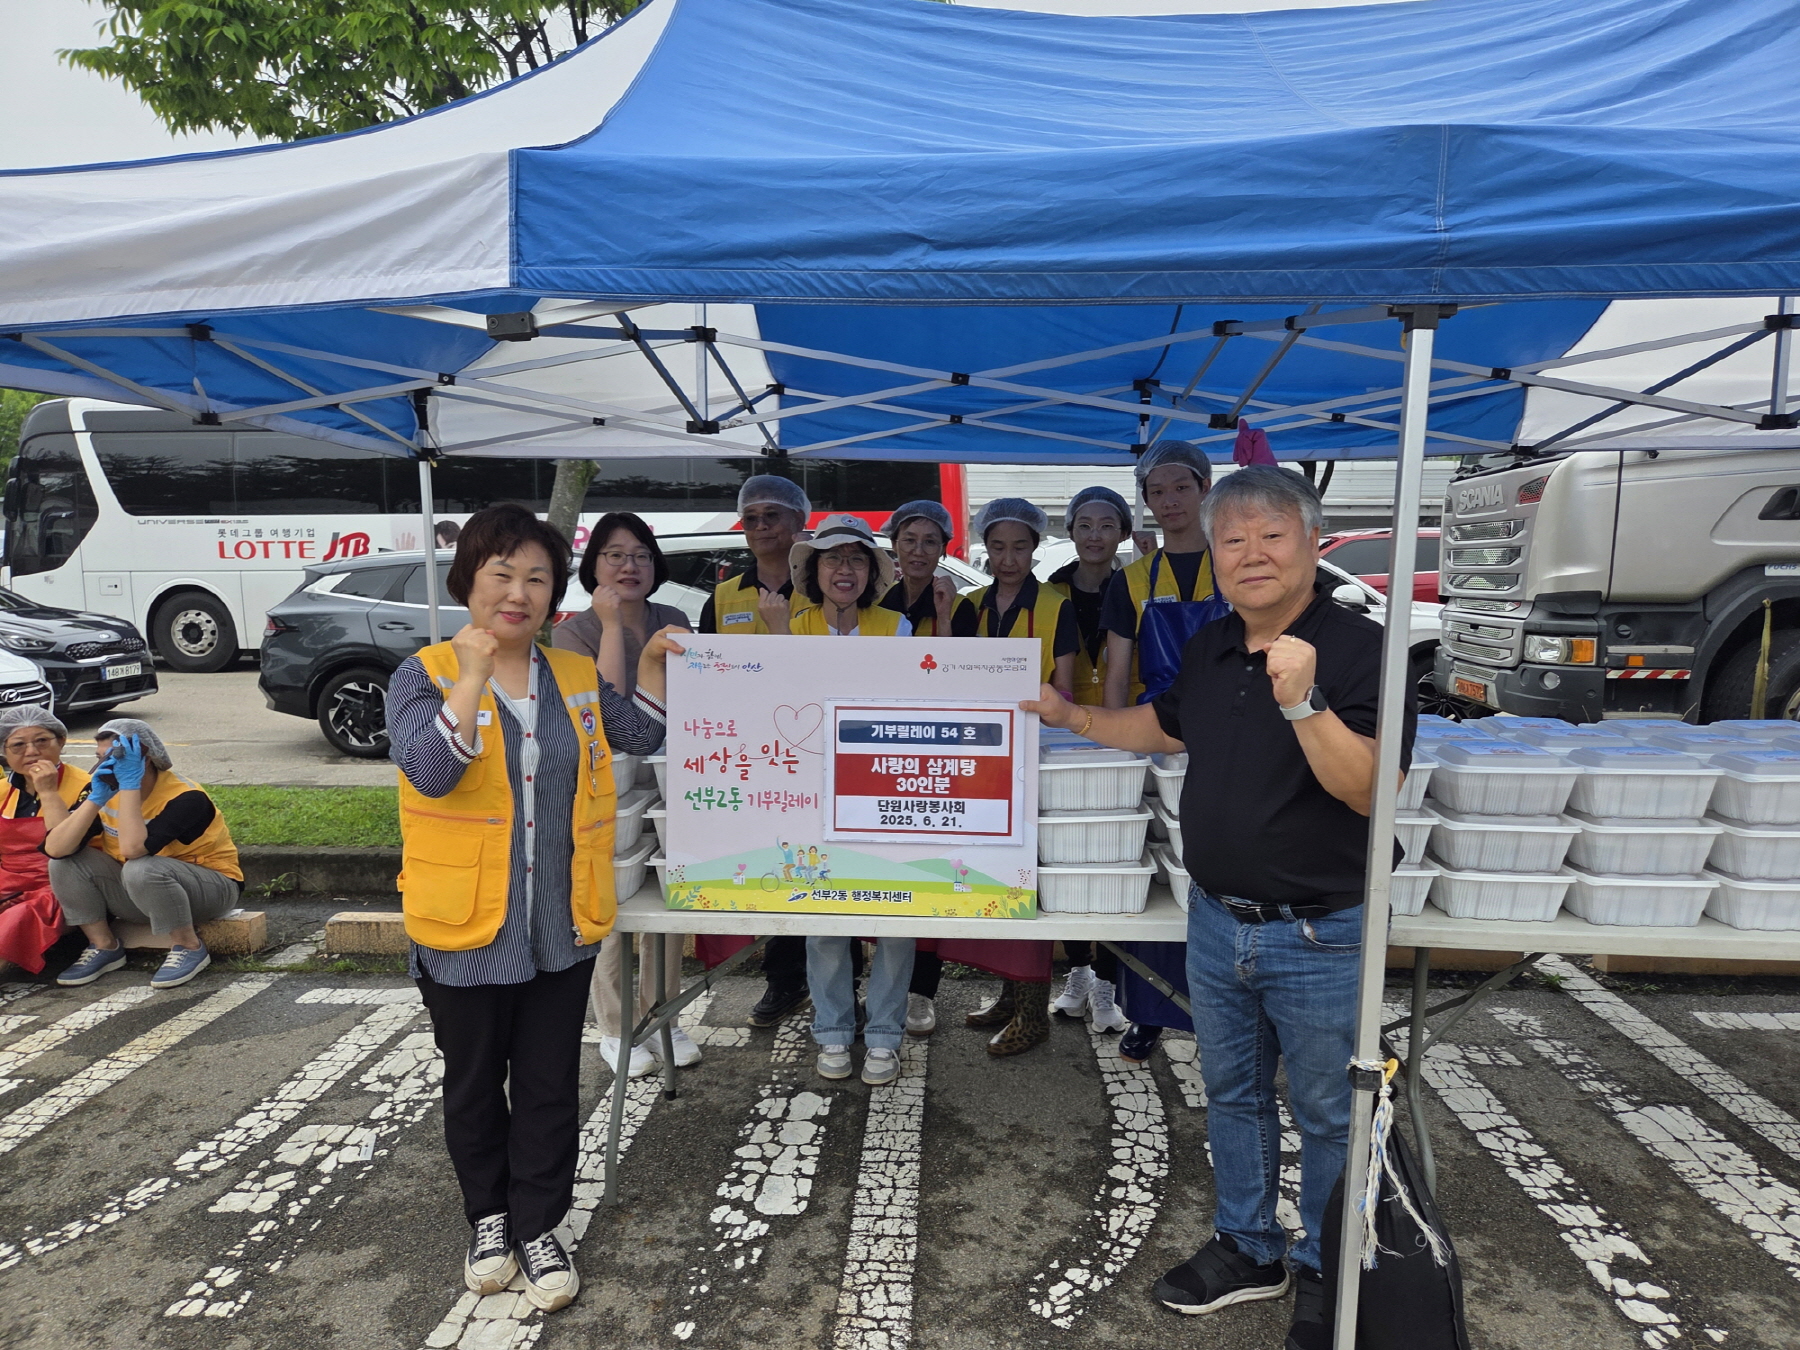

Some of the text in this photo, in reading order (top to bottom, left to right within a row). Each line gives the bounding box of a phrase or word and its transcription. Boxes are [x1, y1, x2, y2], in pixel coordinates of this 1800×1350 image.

[1459, 484, 1504, 511] SCANIA
[217, 527, 315, 538] 롯데그룹 여행기업
[218, 532, 370, 562] LOTTE JTB
[958, 664, 1027, 674] 사회복지공동모금회
[684, 717, 738, 740] 나눔으로
[871, 724, 977, 740] 기부릴레이 54 호
[683, 739, 800, 781] 세상을 잇는
[871, 756, 977, 777] 사랑의 삼계탕
[896, 776, 951, 794] 30인분
[684, 785, 819, 813] 선부2동 기부릴레이
[877, 799, 966, 815] 단원사랑봉사회
[880, 814, 962, 828] 2025. 6. 21.
[811, 889, 912, 903] 선부2동 행정복지센터
